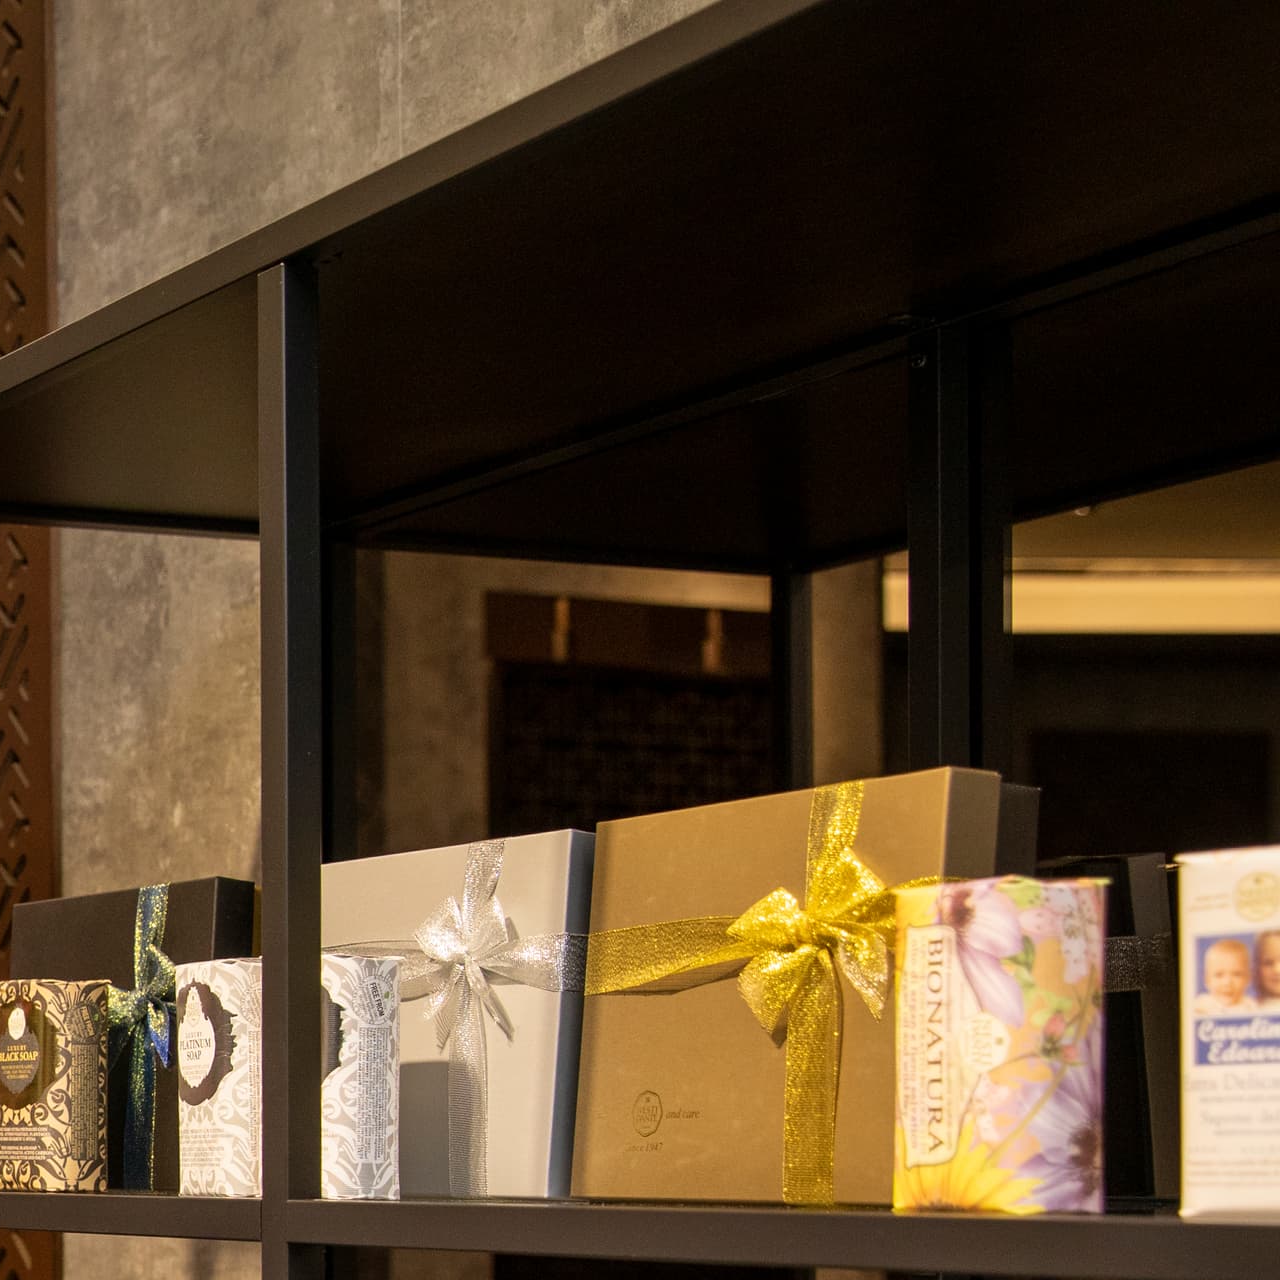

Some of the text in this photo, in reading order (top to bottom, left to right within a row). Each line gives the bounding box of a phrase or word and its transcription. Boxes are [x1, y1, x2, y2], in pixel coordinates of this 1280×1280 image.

[179, 1038, 212, 1051] PLATINUM
[926, 938, 944, 1154] BIONATURA
[19, 1050, 39, 1062] SOAP
[186, 1050, 202, 1062] SOAP
